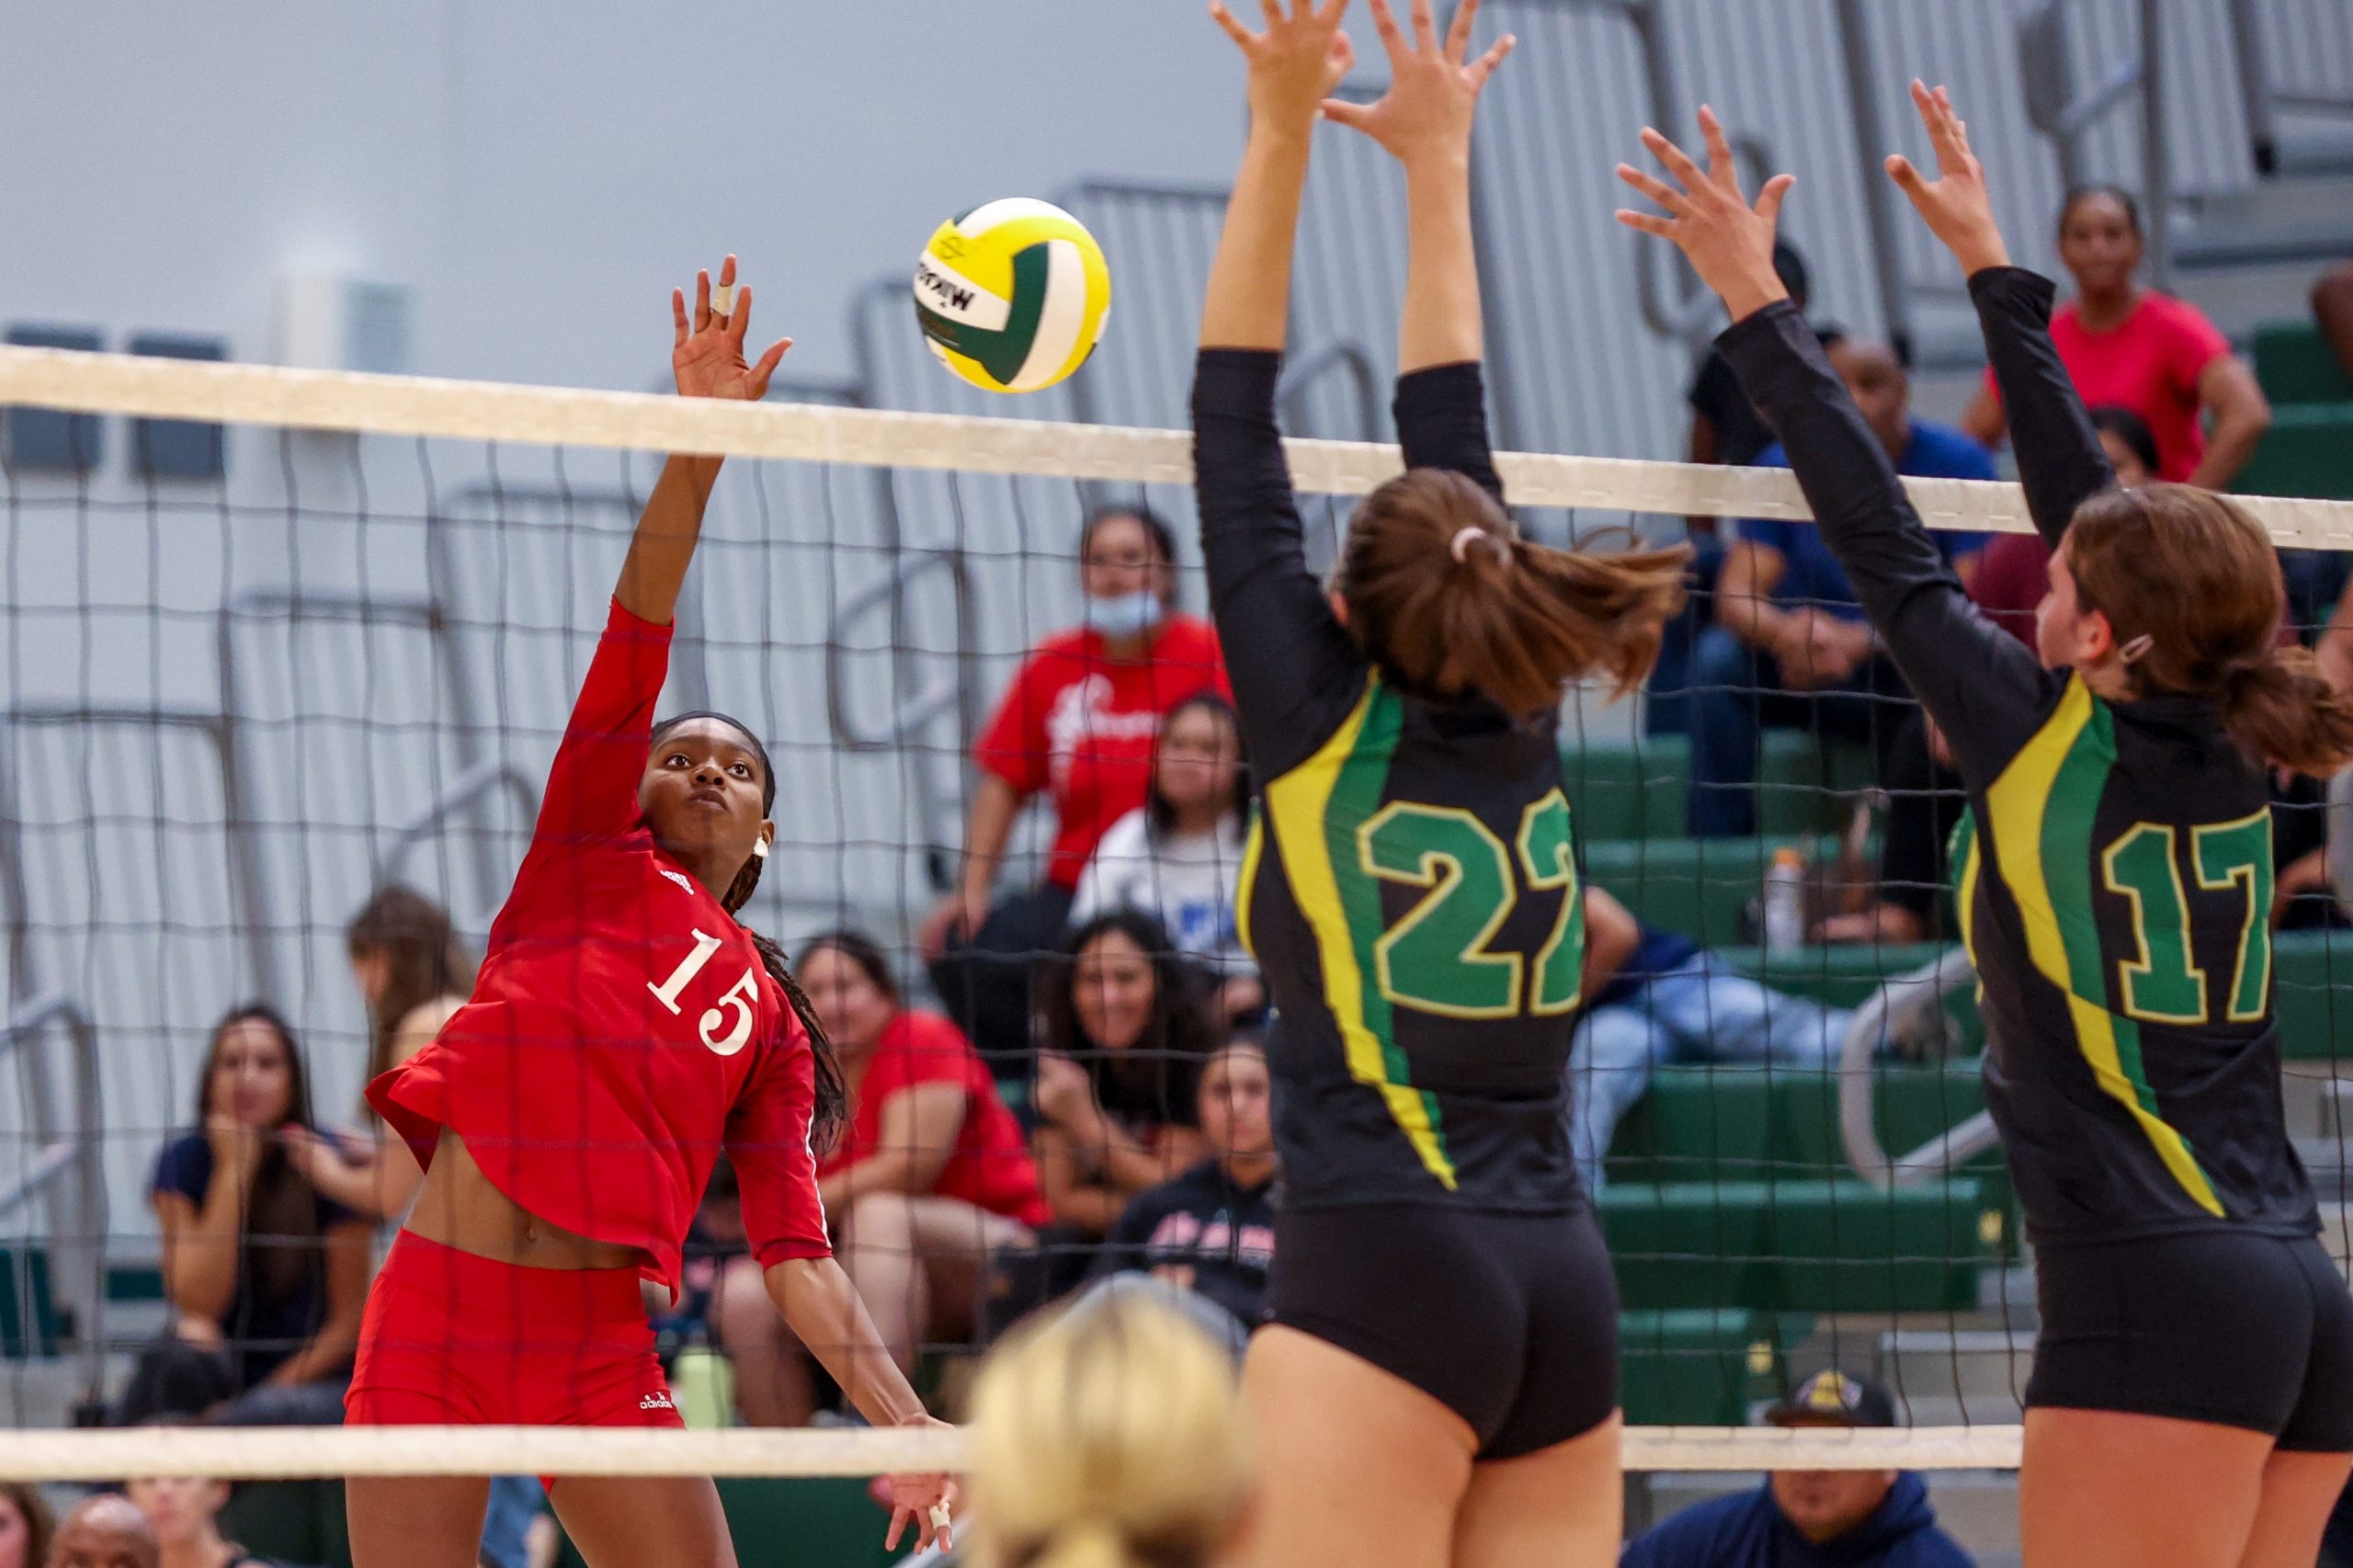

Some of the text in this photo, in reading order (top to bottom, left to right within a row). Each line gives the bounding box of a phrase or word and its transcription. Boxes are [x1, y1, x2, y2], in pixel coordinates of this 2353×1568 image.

[646, 927, 759, 1056] 15
[1357, 786, 1586, 1017] 22
[2101, 804, 2275, 1023] 17
